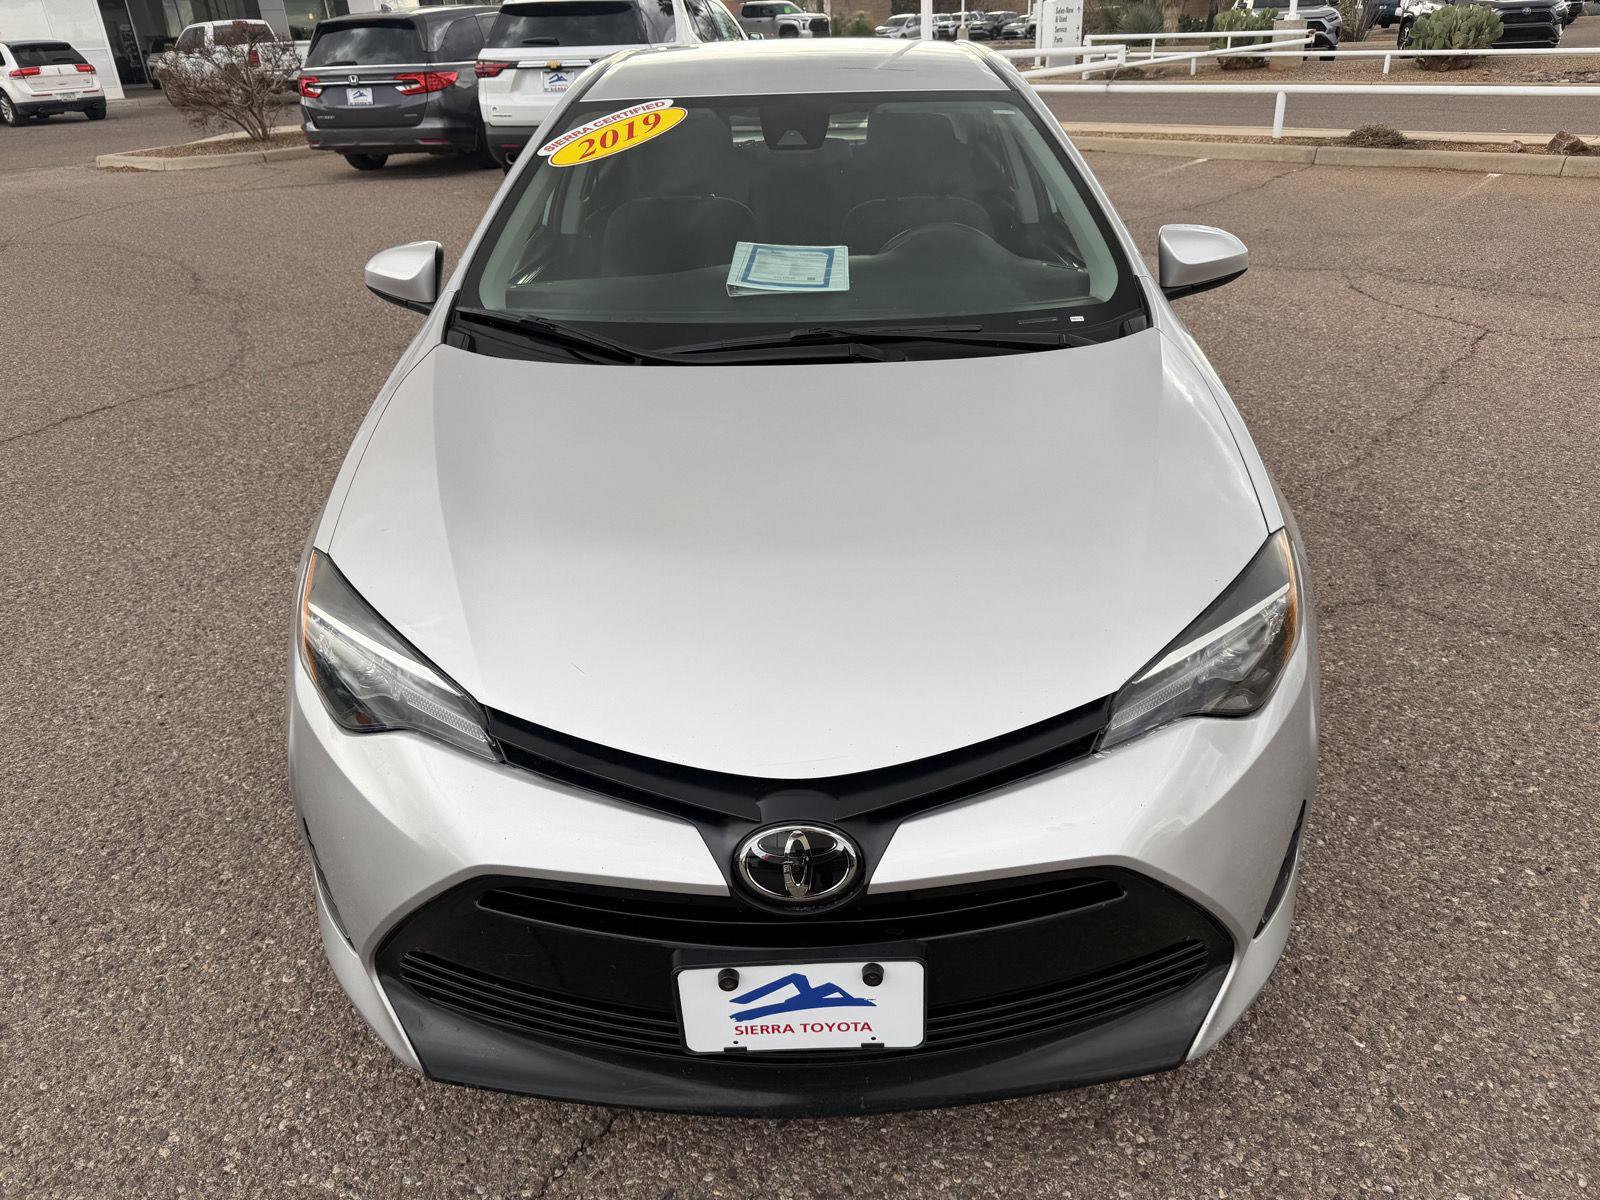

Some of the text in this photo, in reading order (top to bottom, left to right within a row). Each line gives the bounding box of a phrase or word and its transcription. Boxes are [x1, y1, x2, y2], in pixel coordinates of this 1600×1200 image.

[543, 101, 666, 152] SIERRA CERTIFIED
[578, 112, 662, 160] 2019
[734, 1021, 873, 1036] SIERRA TOYOTA
